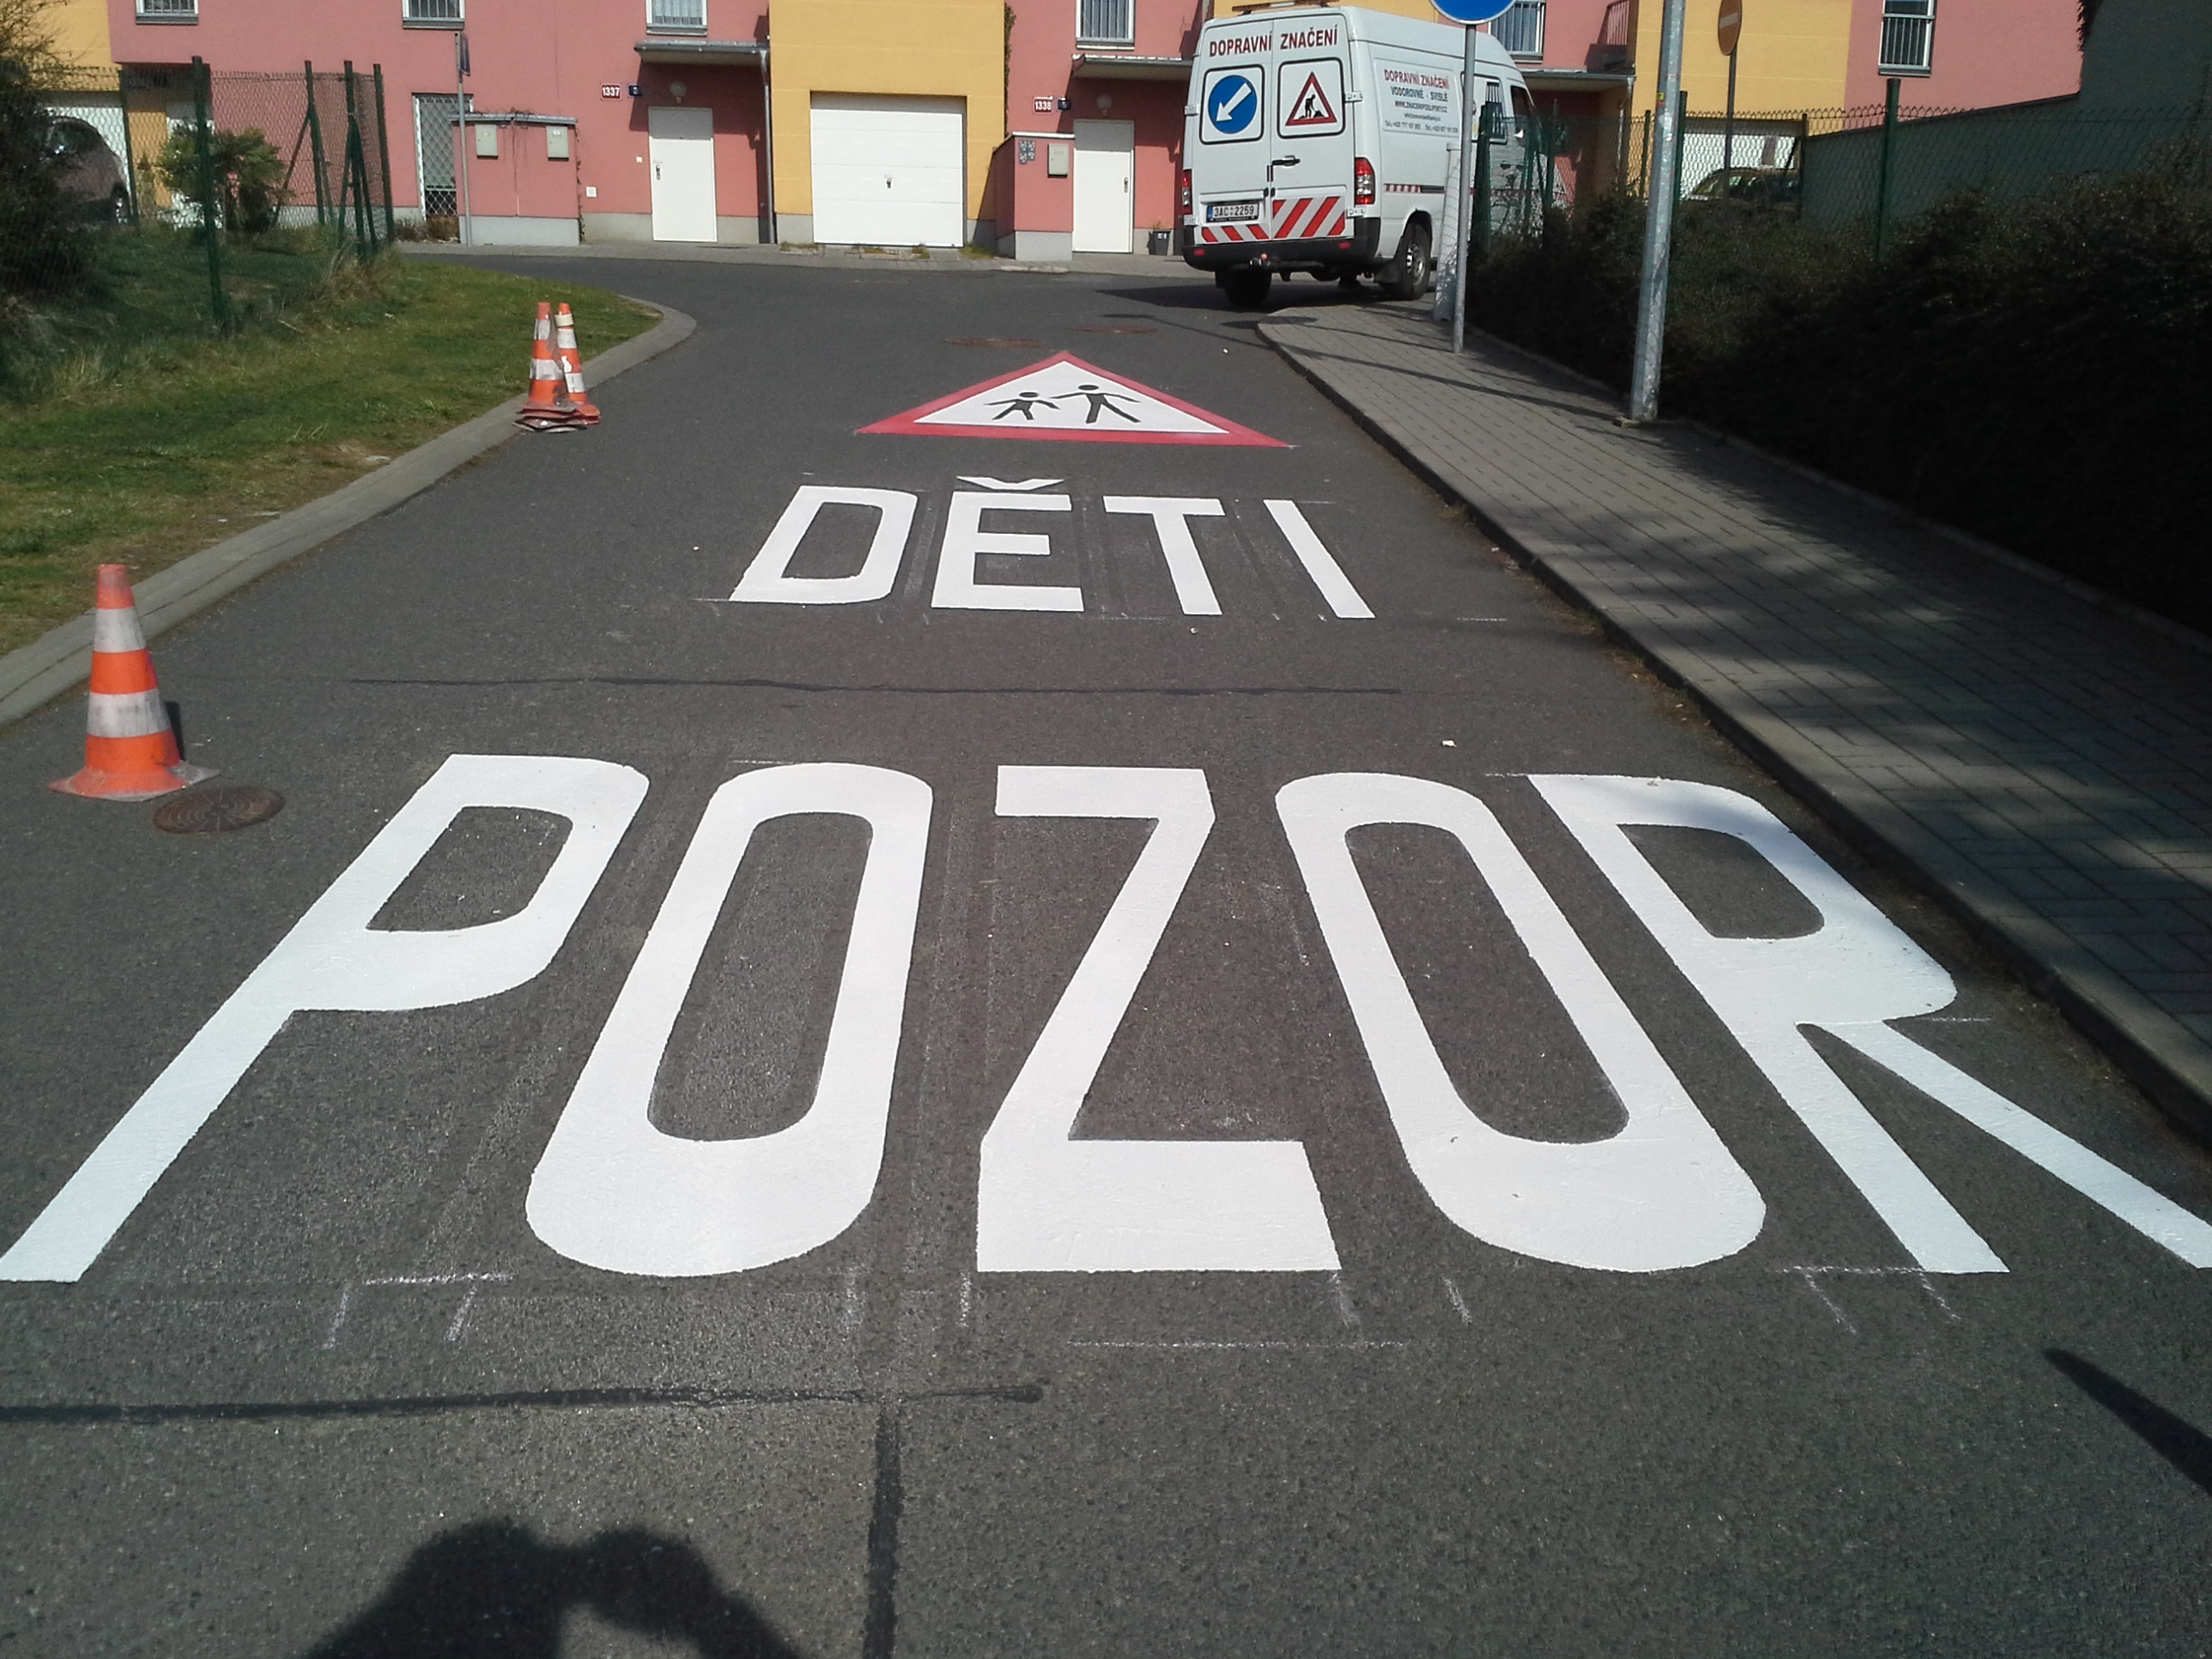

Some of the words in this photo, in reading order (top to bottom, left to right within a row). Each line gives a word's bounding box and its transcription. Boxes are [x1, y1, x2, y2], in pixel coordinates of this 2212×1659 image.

[1210, 31, 1273, 57] DOPRAVNÍ
[1280, 24, 1338, 50] ZNAČENÍ
[1384, 69, 1420, 86] DOPRAVNÍ
[1421, 74, 1450, 89] ZNAČENÍ
[602, 86, 620, 97] 1337
[1430, 91, 1448, 102] SVISLÉ
[1034, 101, 1052, 111] 1338
[1235, 206, 1254, 216] 2259
[729, 475, 1376, 620] DĚTI
[0, 754, 2212, 1281] POZOR
